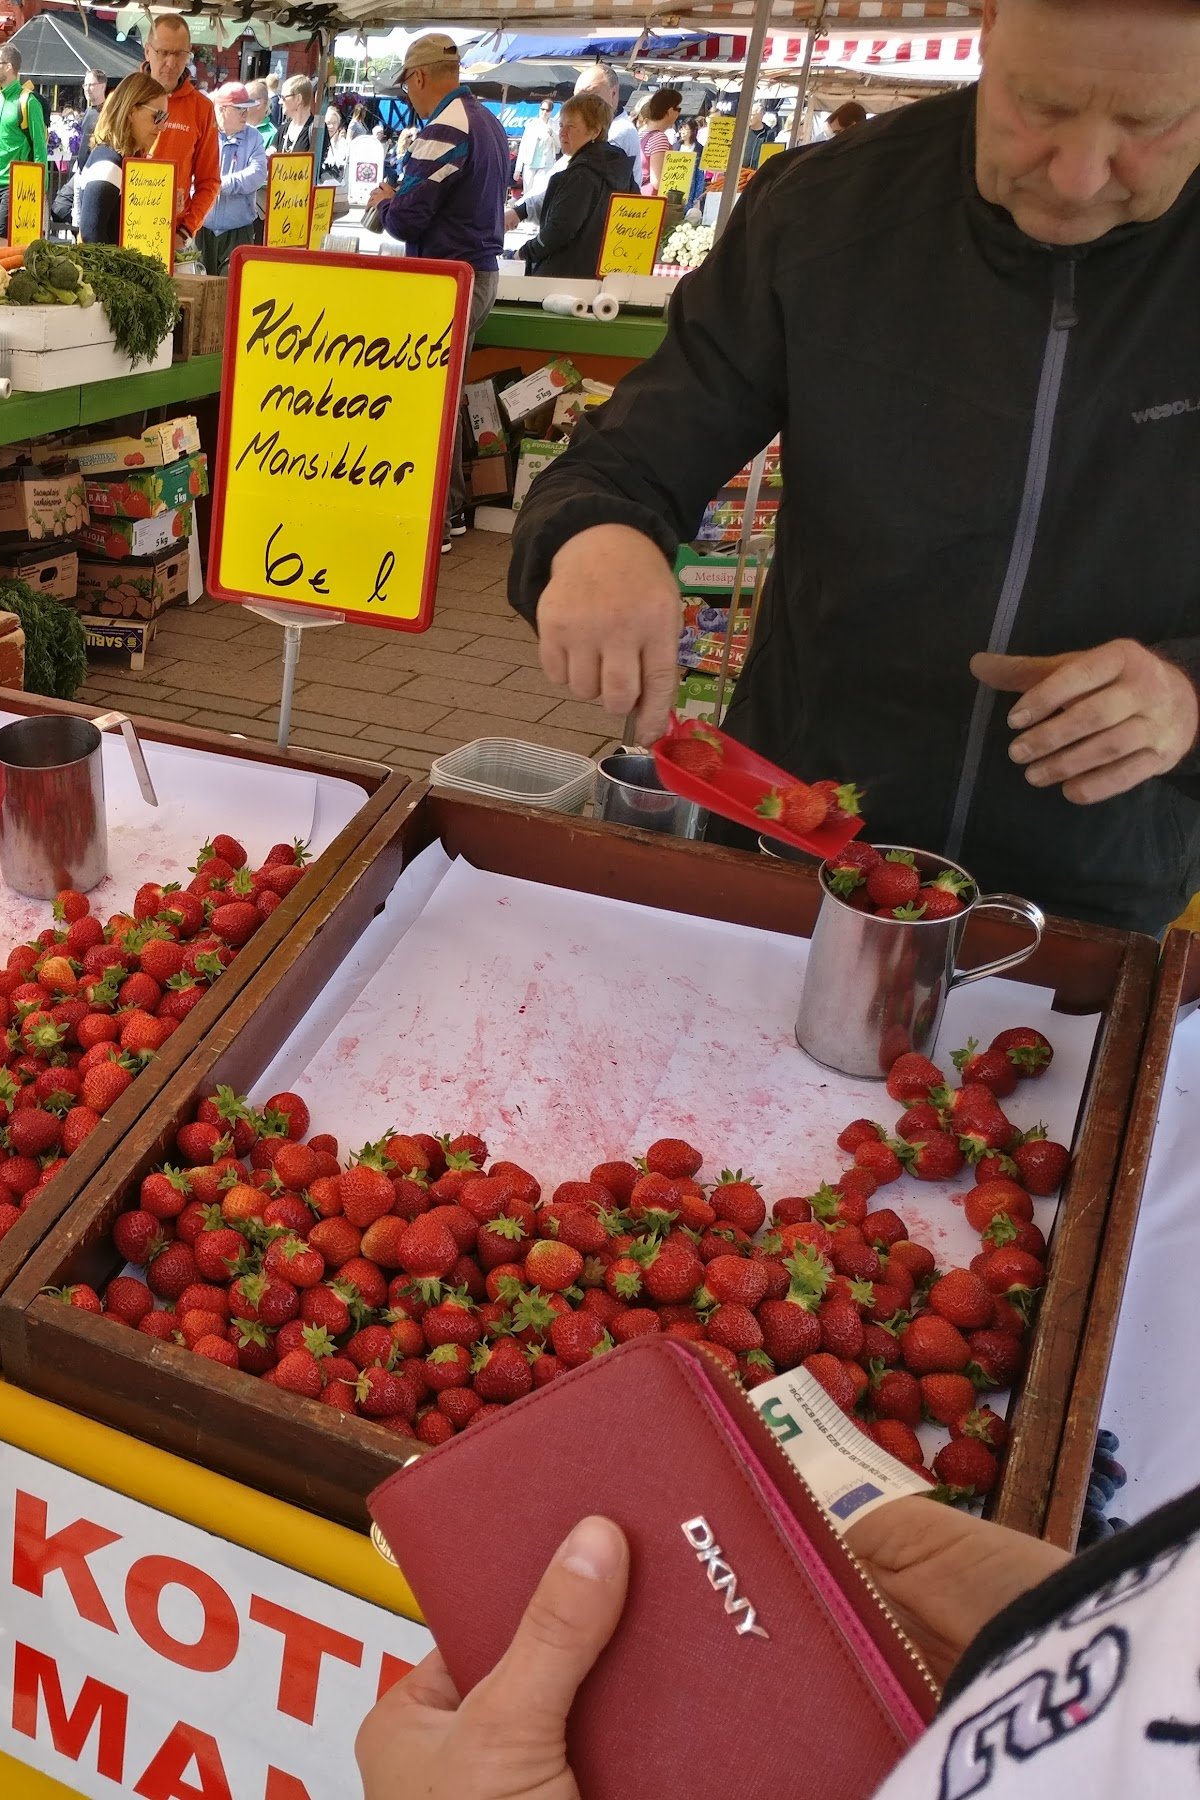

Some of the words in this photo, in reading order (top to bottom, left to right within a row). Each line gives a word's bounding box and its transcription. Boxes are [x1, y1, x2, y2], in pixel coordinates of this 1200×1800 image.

[760, 1396, 803, 1443] 5
[11, 1488, 417, 1727] KOT
[680, 1515, 770, 1639] DKNY
